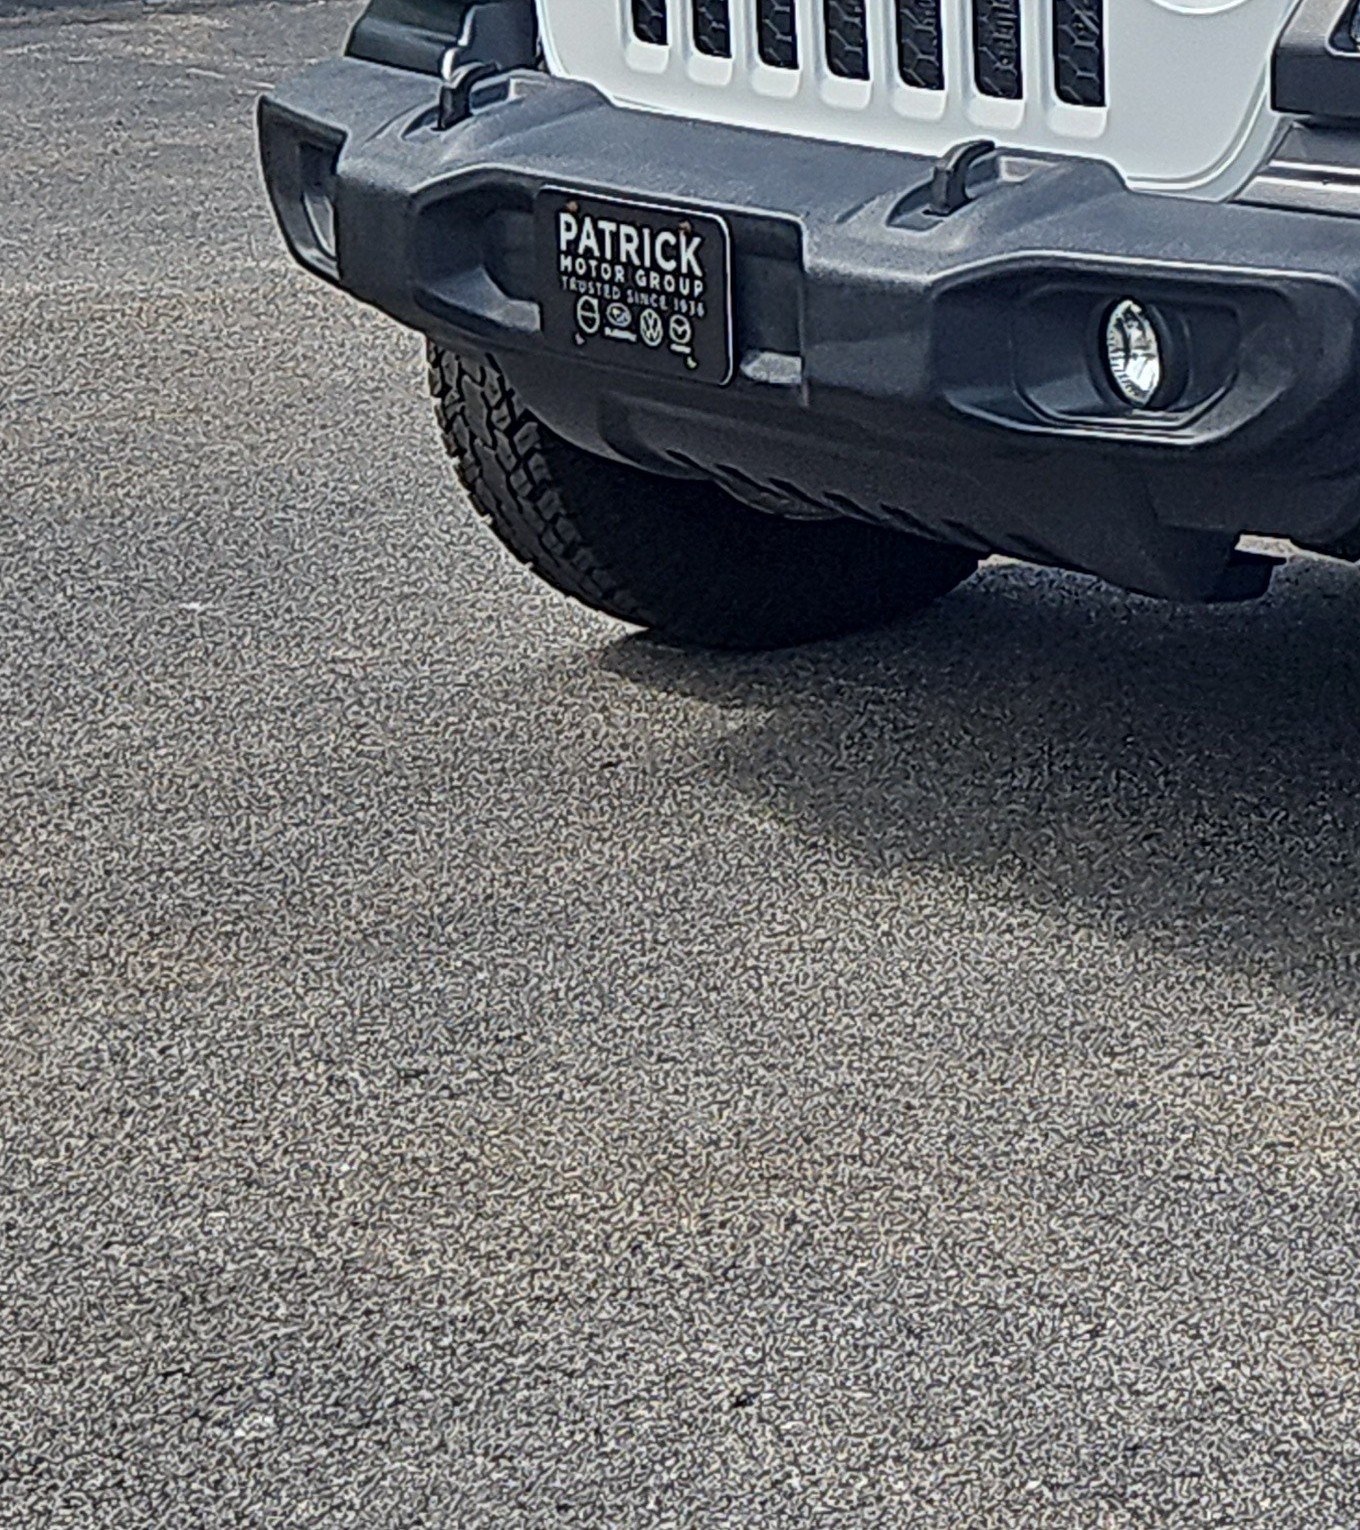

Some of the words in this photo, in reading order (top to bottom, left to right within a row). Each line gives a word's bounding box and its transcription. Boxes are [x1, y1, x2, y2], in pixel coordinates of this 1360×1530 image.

[559, 212, 703, 278] PATRICK
[560, 254, 625, 283] MOTOR
[635, 269, 704, 298] GROUP
[561, 275, 621, 300] TRUSTED
[627, 289, 668, 311] SINCE
